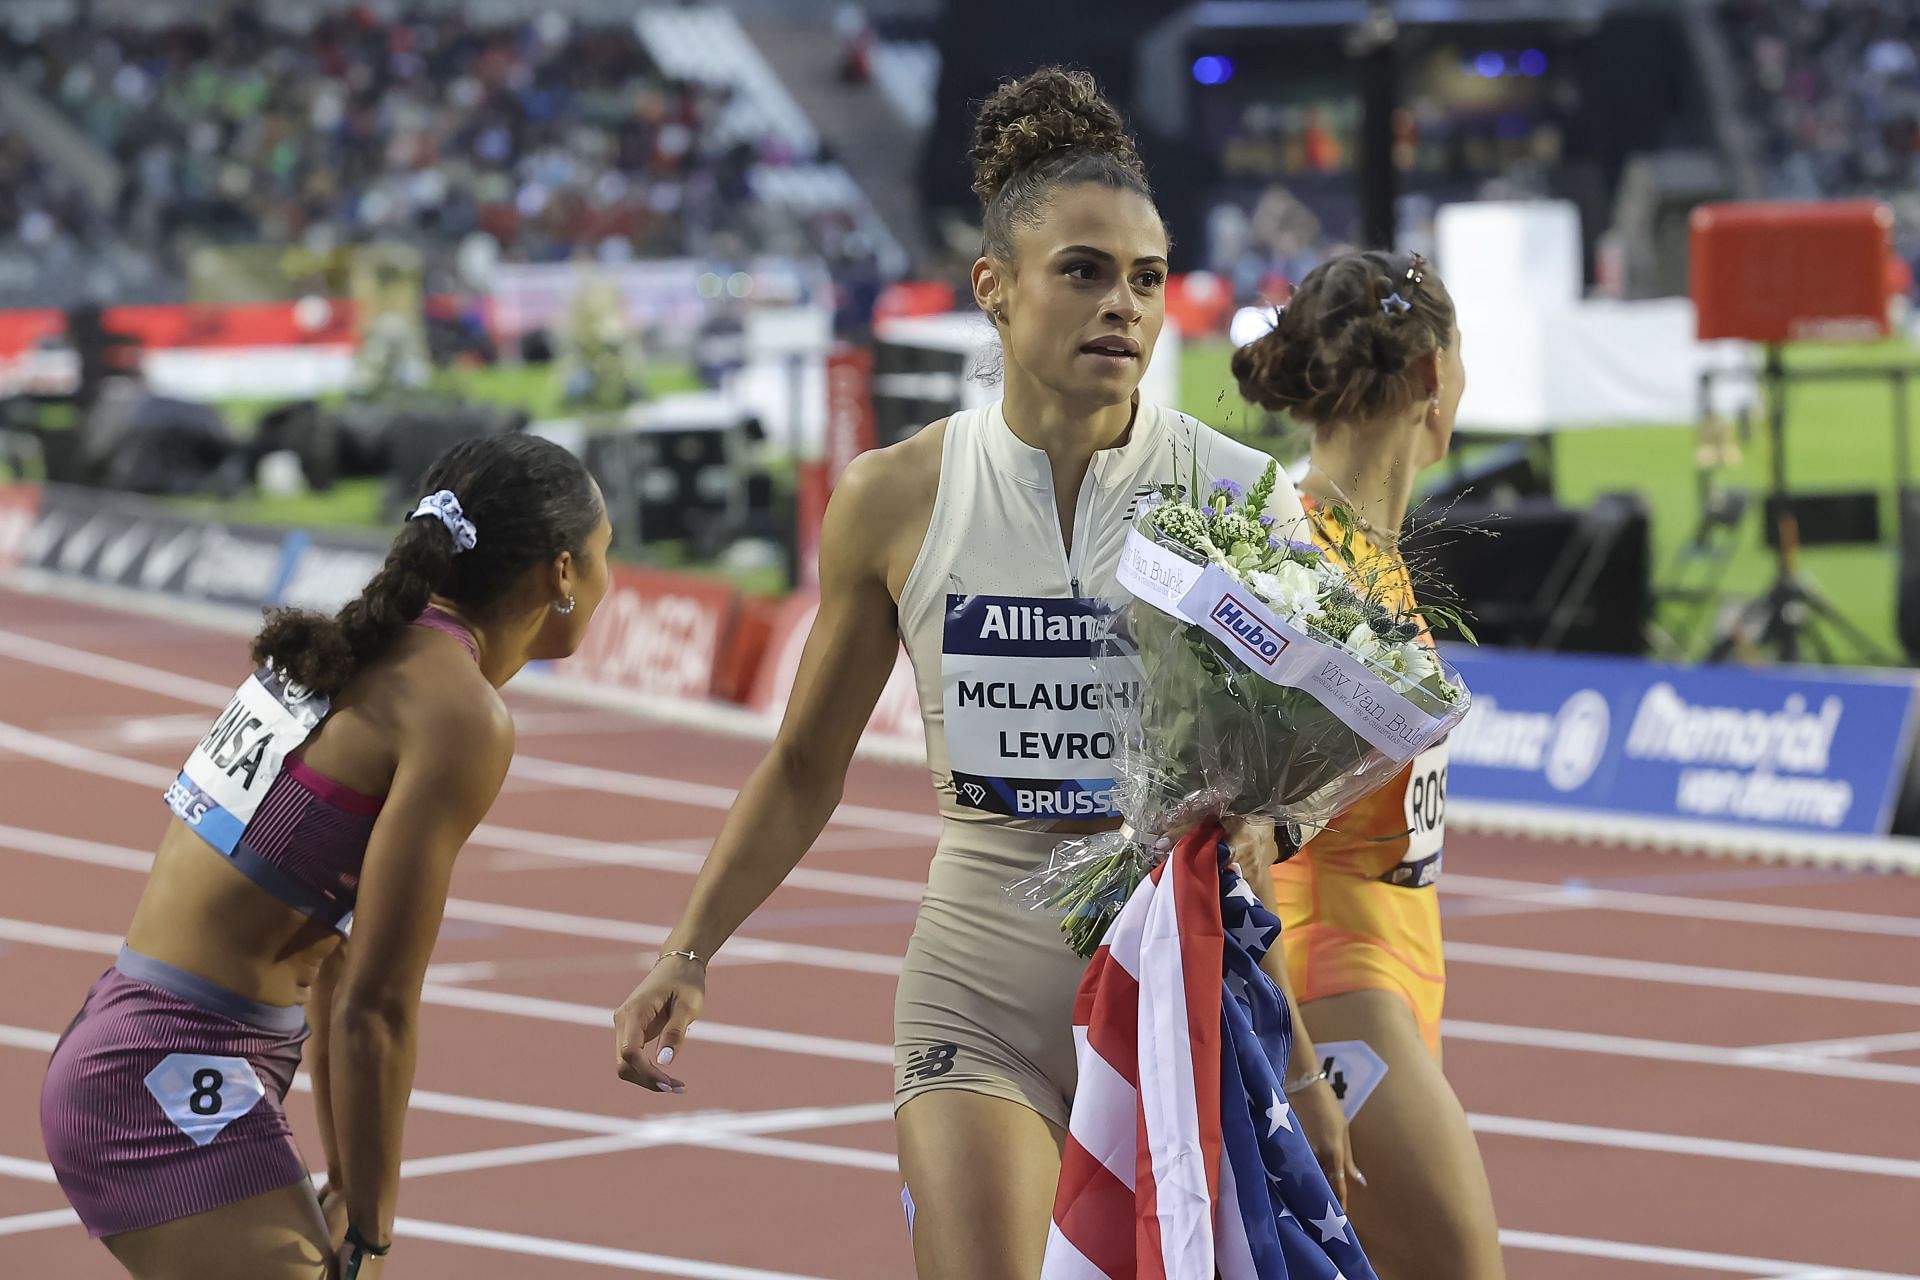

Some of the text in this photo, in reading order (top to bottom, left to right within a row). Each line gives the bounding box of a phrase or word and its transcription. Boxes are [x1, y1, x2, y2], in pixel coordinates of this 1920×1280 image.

[1215, 602, 1278, 656] Hubo
[1320, 660, 1352, 687] Viv
[1351, 682, 1387, 722] Van
[164, 783, 208, 825] SELS
[190, 1071, 223, 1115] 8
